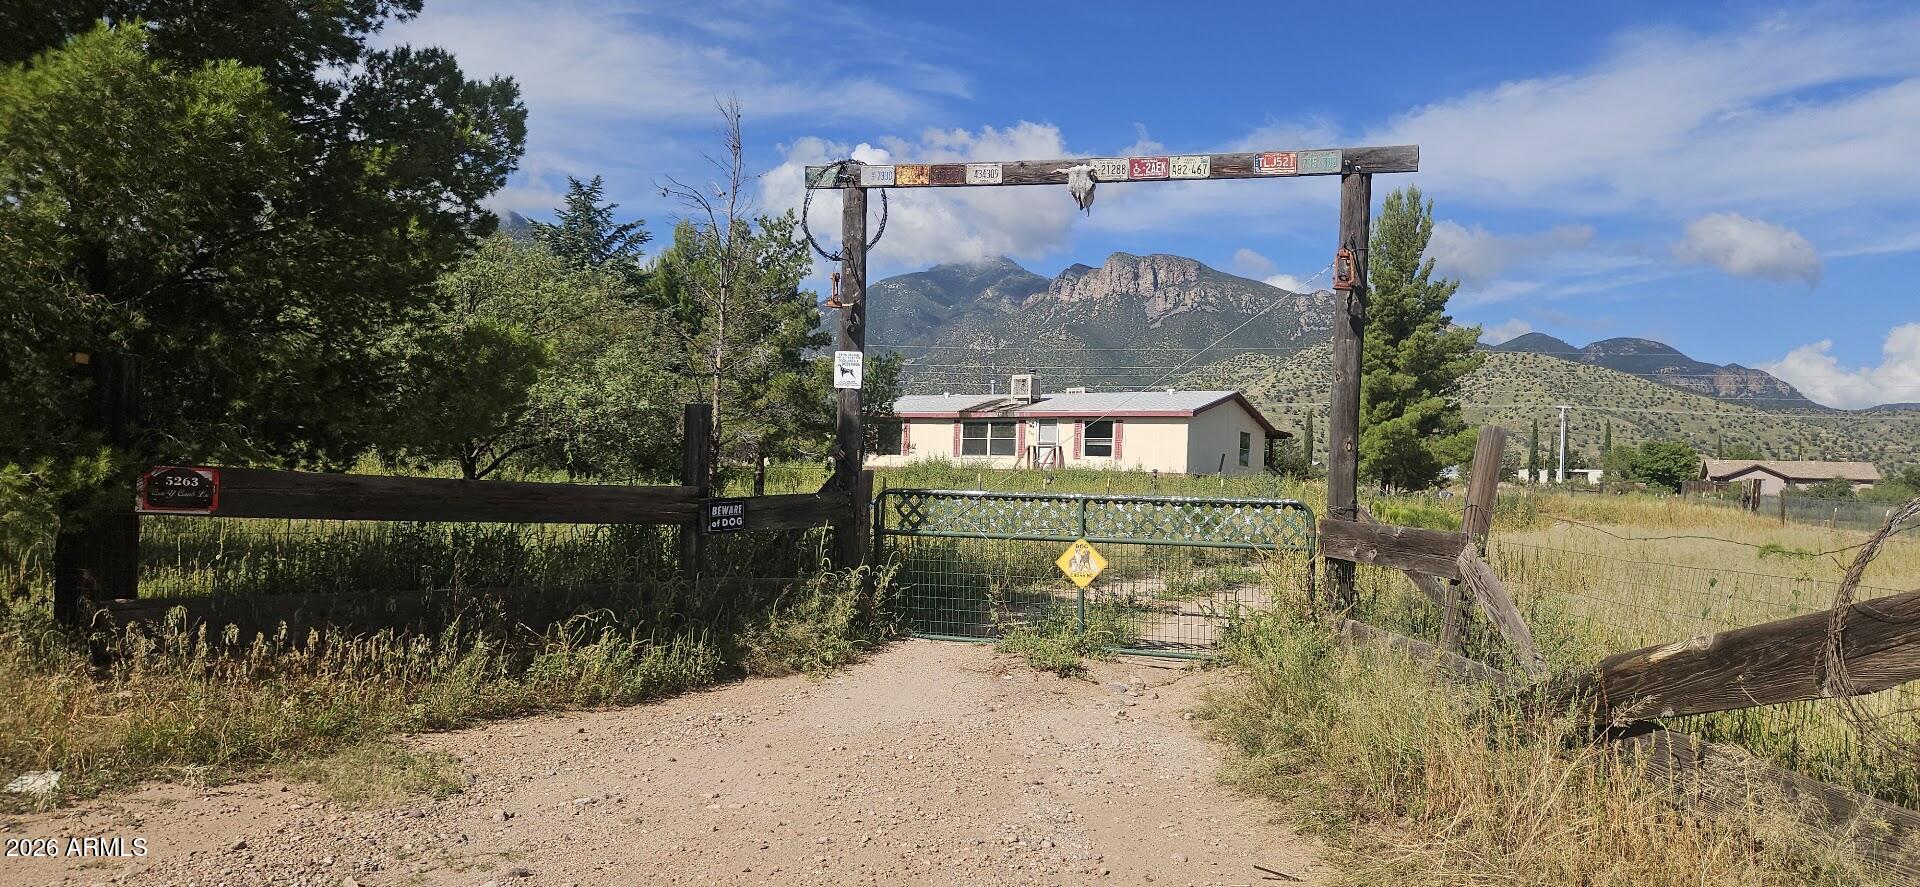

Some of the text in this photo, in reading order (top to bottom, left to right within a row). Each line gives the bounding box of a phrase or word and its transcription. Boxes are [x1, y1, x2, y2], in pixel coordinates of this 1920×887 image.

[165, 476, 200, 487] 5263
[711, 504, 743, 515] BEWARE
[711, 517, 743, 528] of DOG
